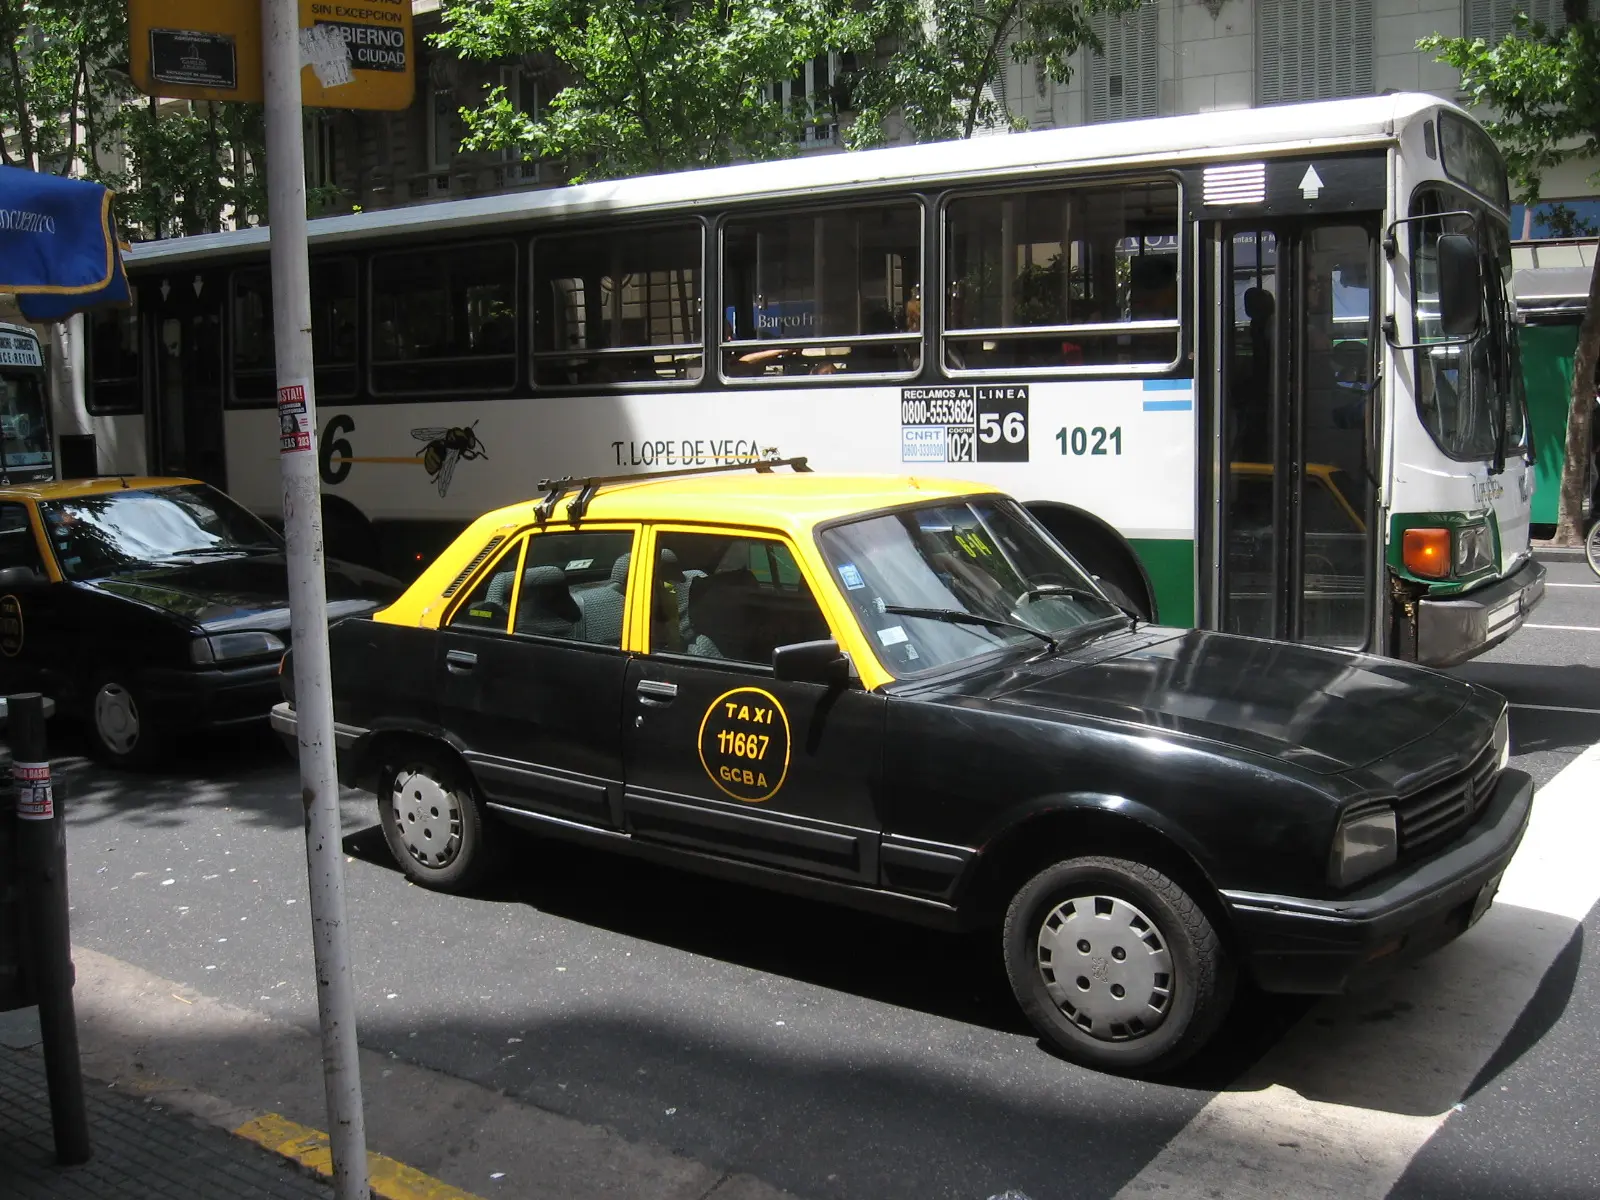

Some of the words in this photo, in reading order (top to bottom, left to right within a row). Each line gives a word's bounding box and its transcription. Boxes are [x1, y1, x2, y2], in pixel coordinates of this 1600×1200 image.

[311, 4, 332, 14] SIN
[335, 6, 402, 23] EXCEPCION
[328, 25, 404, 47] OBIERNO
[357, 48, 405, 65] CIUDAD
[0, 209, 56, 235] ncuentro
[904, 389, 956, 399] RECLAMOS
[958, 388, 971, 398] AL
[979, 389, 1026, 399] LINEA
[902, 399, 974, 424] 0800-5553682
[905, 431, 942, 441] CNRT
[979, 412, 1026, 444] 56
[947, 433, 975, 462] 1021
[1055, 426, 1122, 456] 1021
[631, 441, 675, 466] LOPE
[682, 440, 707, 465] DE
[710, 440, 760, 465] VEGA
[725, 702, 773, 724] TAXI
[717, 729, 769, 760] 11667
[720, 765, 768, 788] GCBA
